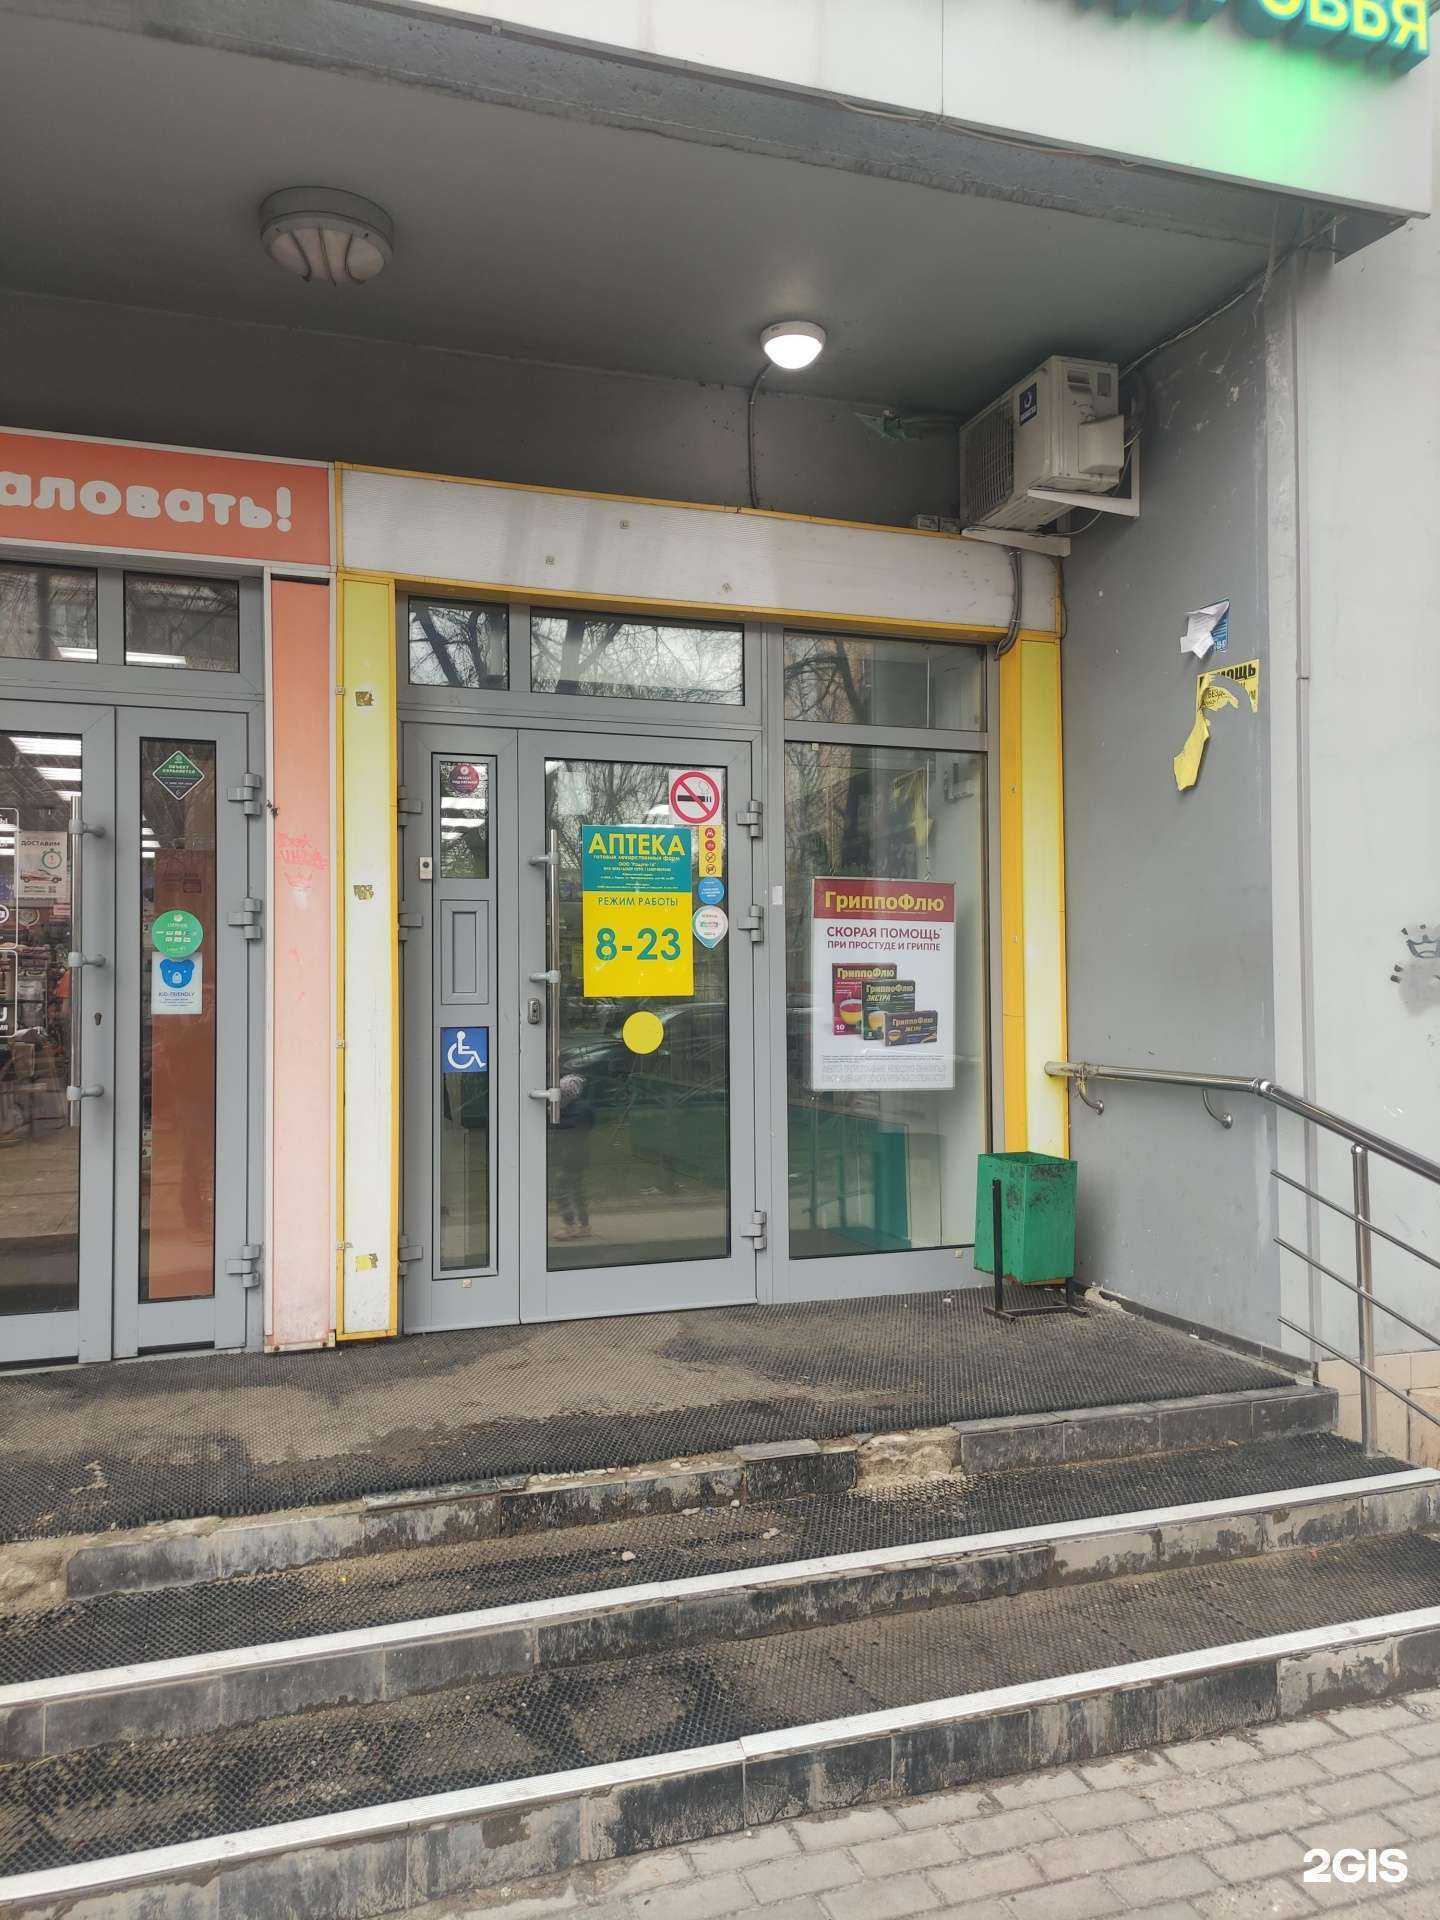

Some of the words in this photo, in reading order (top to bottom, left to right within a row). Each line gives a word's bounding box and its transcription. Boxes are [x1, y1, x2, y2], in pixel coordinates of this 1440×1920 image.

[588, 833, 685, 856] АПТЕКА
[598, 896, 635, 906] РЕЖИМ
[638, 897, 678, 906] РАБОТЫ
[824, 891, 945, 912] ГриппоФлю
[826, 926, 877, 938] СКОРАЯ
[880, 928, 941, 941] ПОМОЩЬ
[595, 927, 681, 960] 8-23
[827, 940, 847, 950] ПРИ
[848, 940, 896, 951] ПРОСТУДЕ
[898, 942, 905, 951] И
[906, 942, 941, 952] ГРИППЕ
